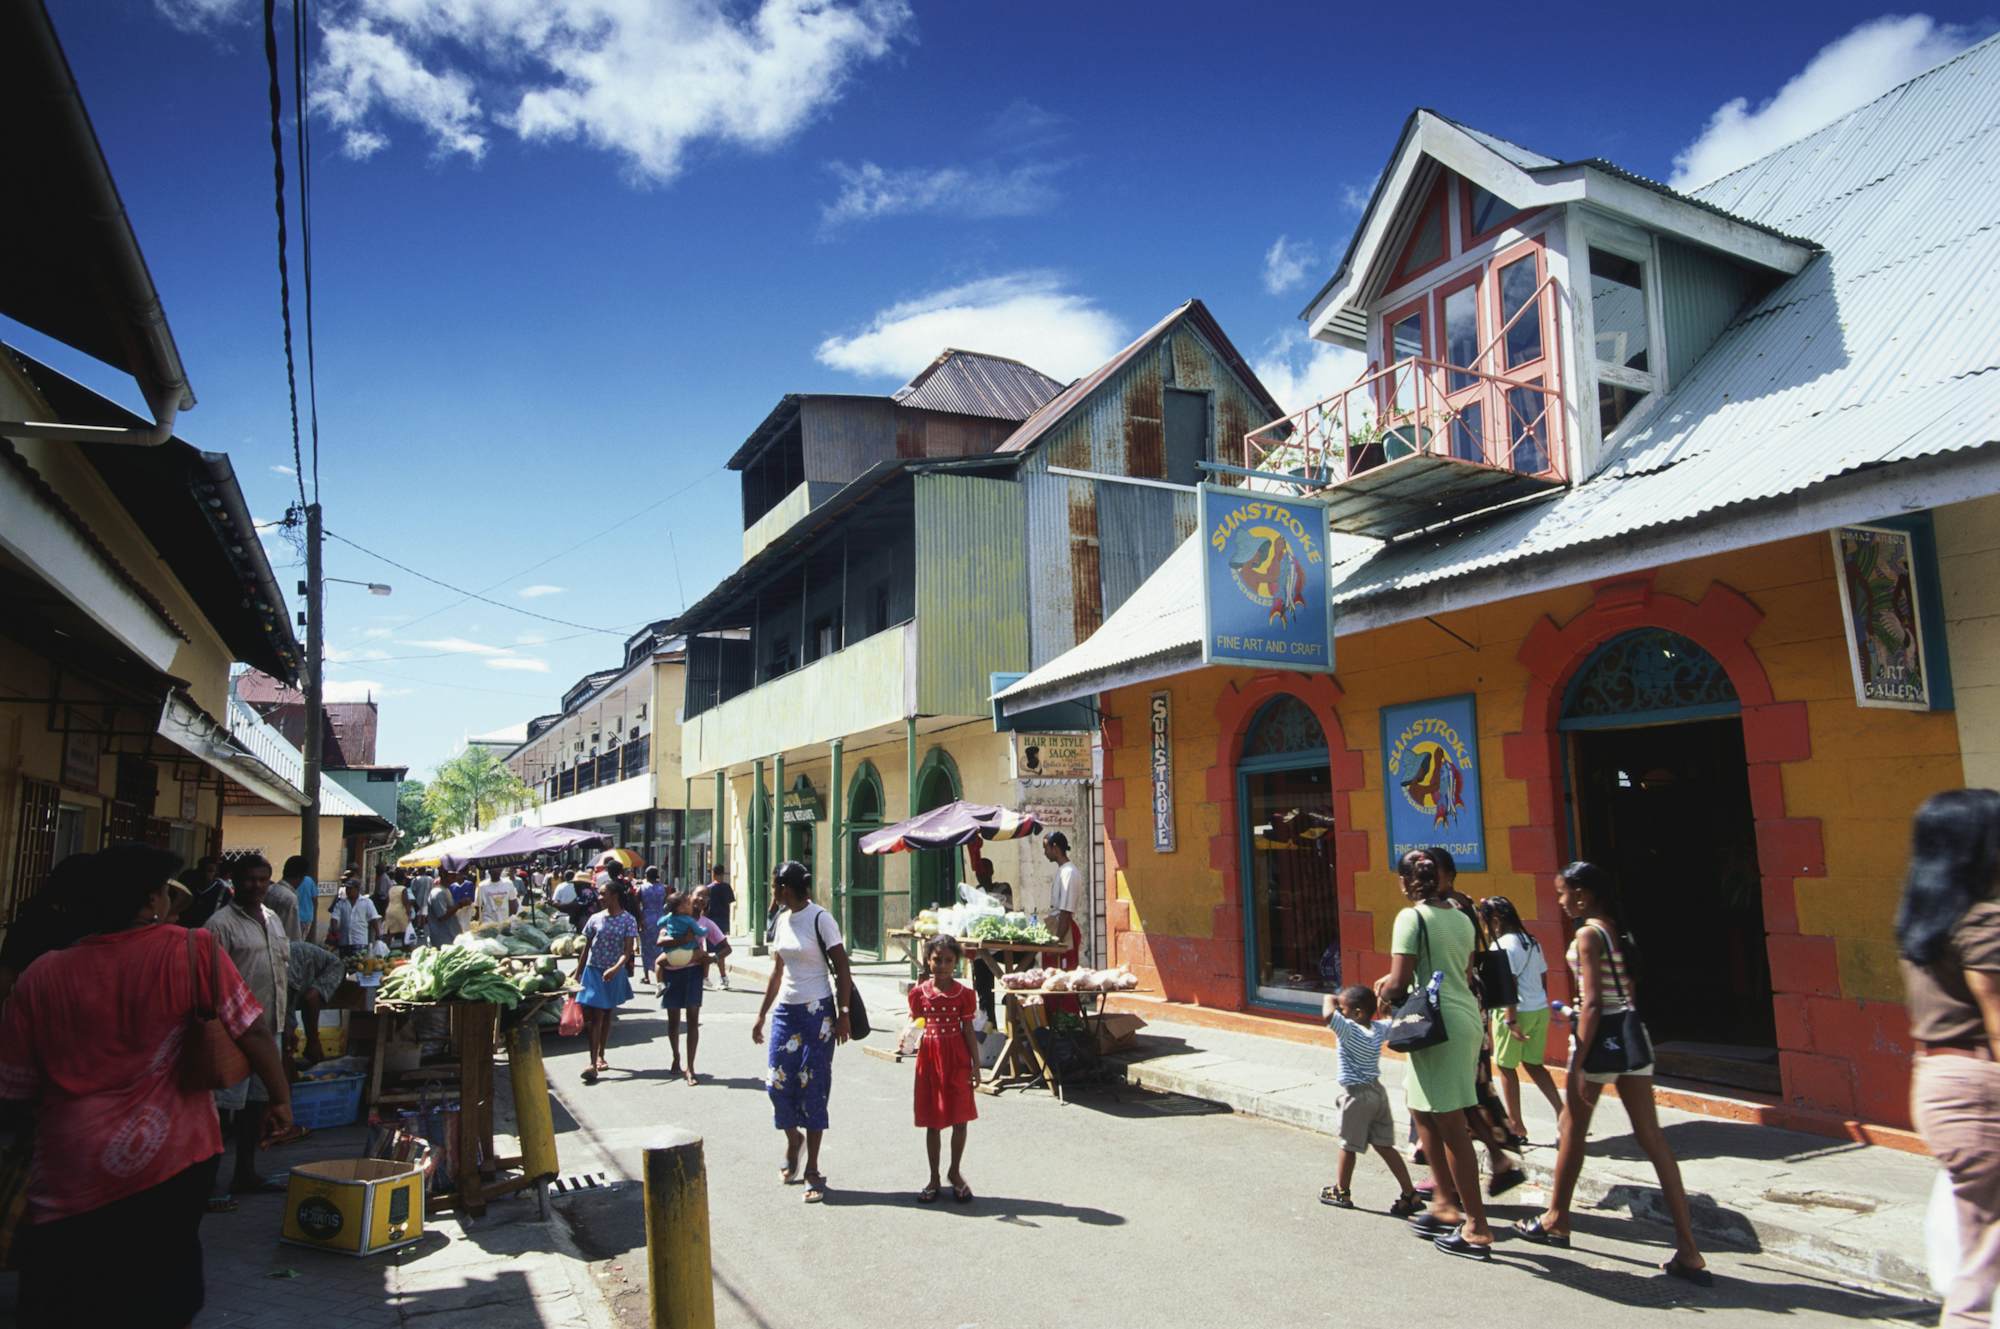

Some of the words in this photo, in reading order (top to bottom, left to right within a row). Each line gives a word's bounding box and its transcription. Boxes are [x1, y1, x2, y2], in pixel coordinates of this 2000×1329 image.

[1212, 502, 1322, 564] SUNSTROKE
[1216, 634, 1240, 650] FINE
[1243, 637, 1263, 651] ART
[1265, 640, 1287, 654] AND
[1290, 642, 1322, 656] CRAFT
[1876, 665, 1904, 679] ART
[1865, 682, 1923, 699] GALLERY
[1024, 736, 1046, 747] HAIR
[1049, 736, 1058, 747] IN
[1060, 736, 1085, 748] STYLE
[1388, 718, 1473, 775] SUNSTROKE
[1049, 749, 1077, 758] SALON
[1152, 699, 1169, 845] SUNSTROKE
[1450, 843, 1478, 856] CRAFT
